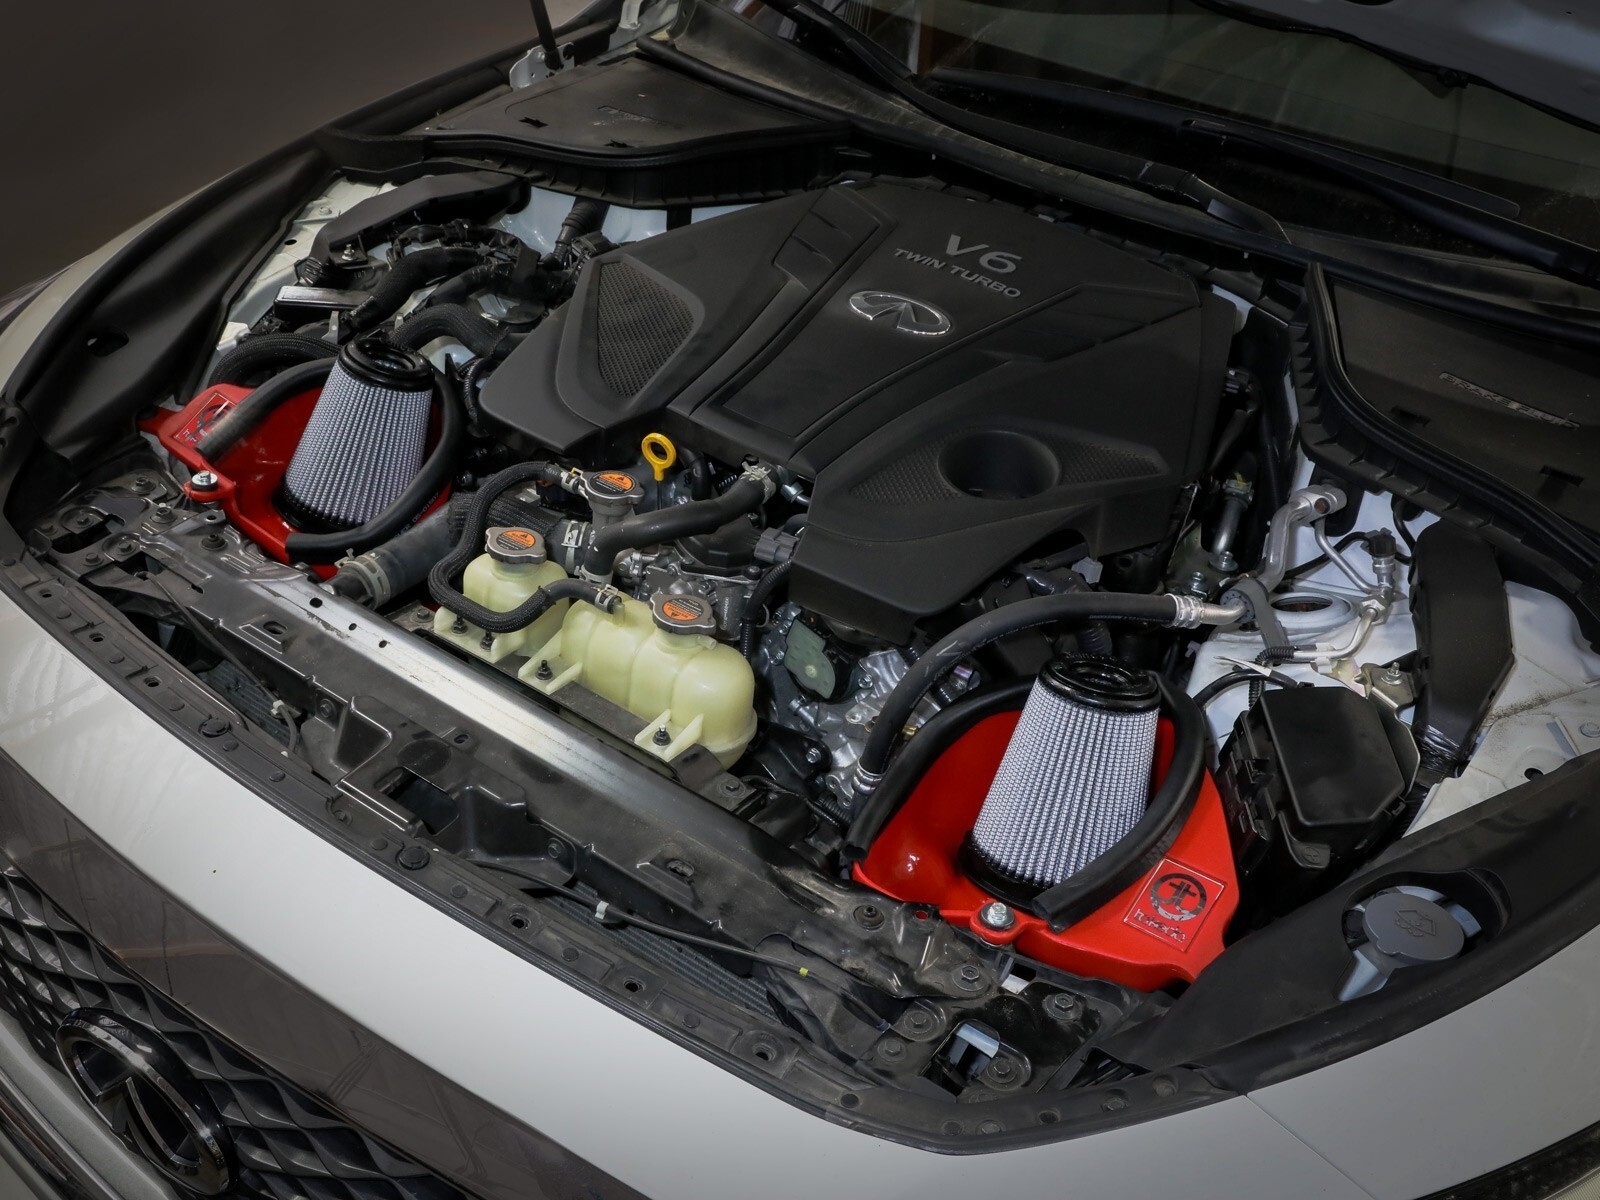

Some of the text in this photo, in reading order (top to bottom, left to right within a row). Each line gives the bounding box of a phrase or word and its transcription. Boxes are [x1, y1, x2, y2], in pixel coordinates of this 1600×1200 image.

[894, 248, 1021, 297] TWIN TURBO
[945, 234, 1022, 273] V6
